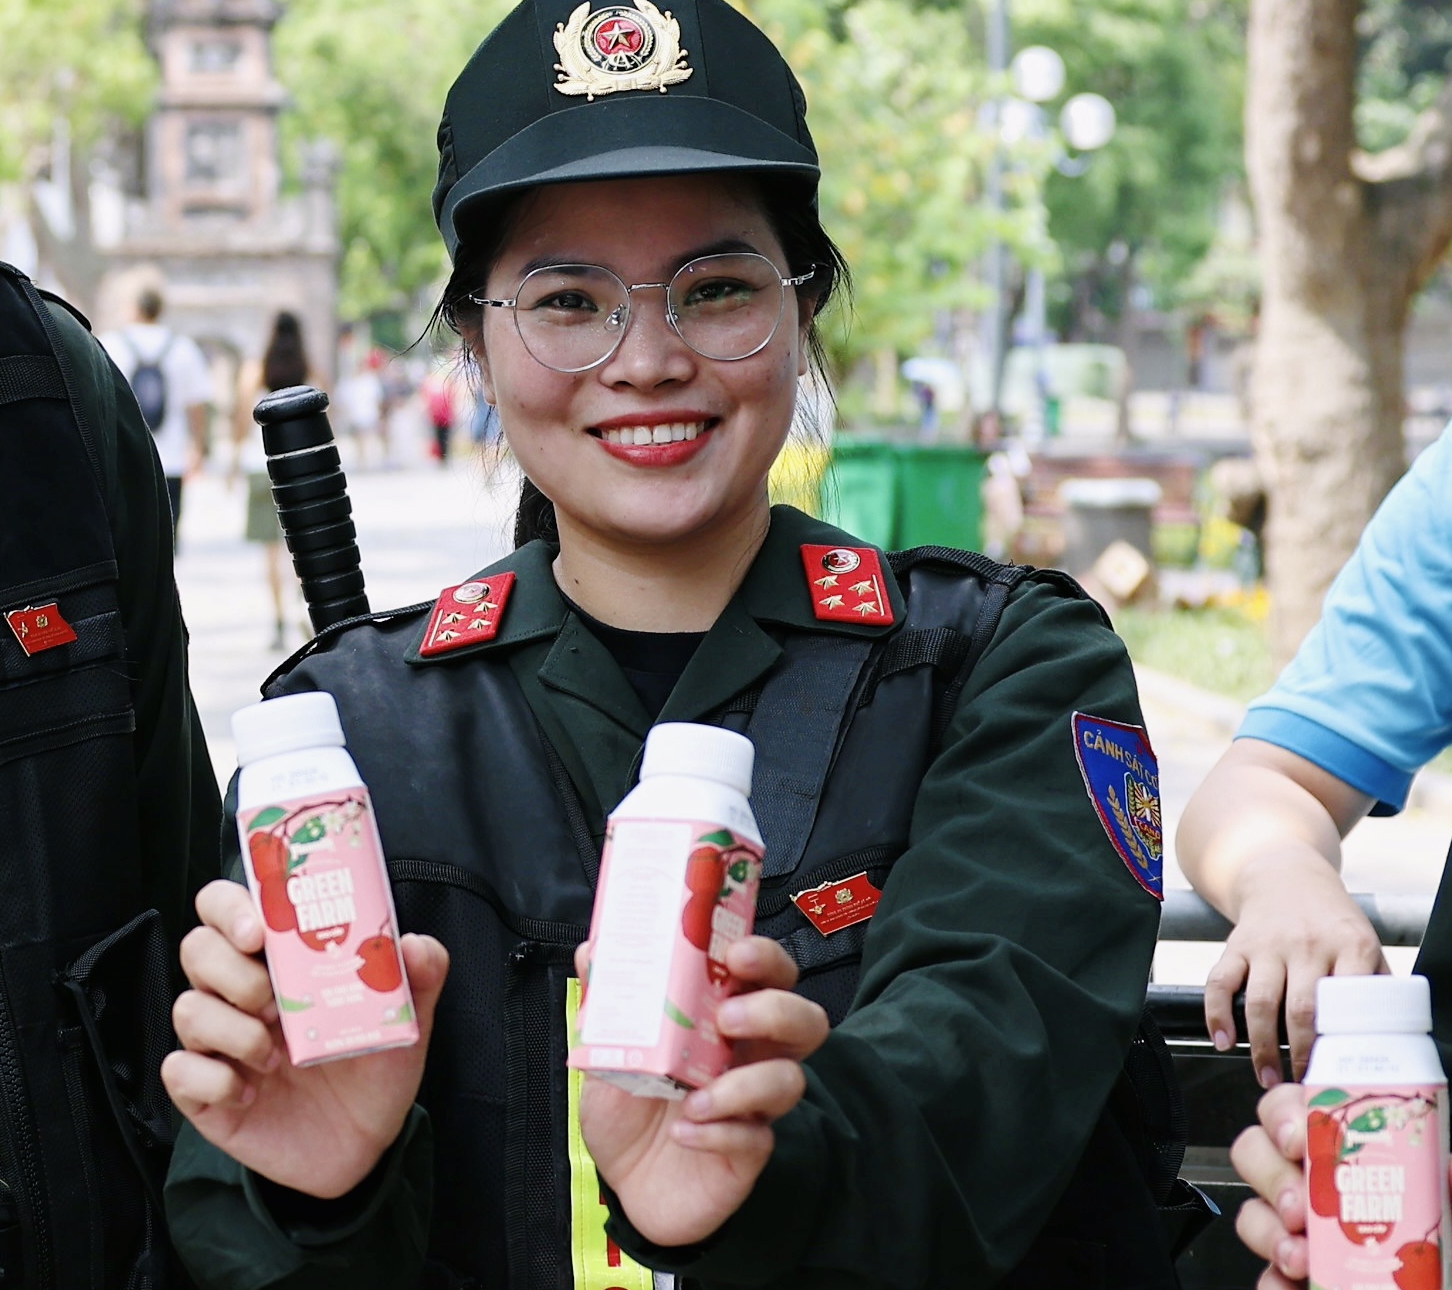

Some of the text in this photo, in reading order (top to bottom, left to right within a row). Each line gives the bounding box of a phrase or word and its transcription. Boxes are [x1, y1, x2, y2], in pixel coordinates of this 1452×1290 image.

[1083, 729, 1125, 764] CẢNH
[287, 867, 355, 905] GREEN
[296, 895, 358, 933] FARM
[1336, 1164, 1406, 1195] GREEN
[1340, 1193, 1404, 1223] FARM
